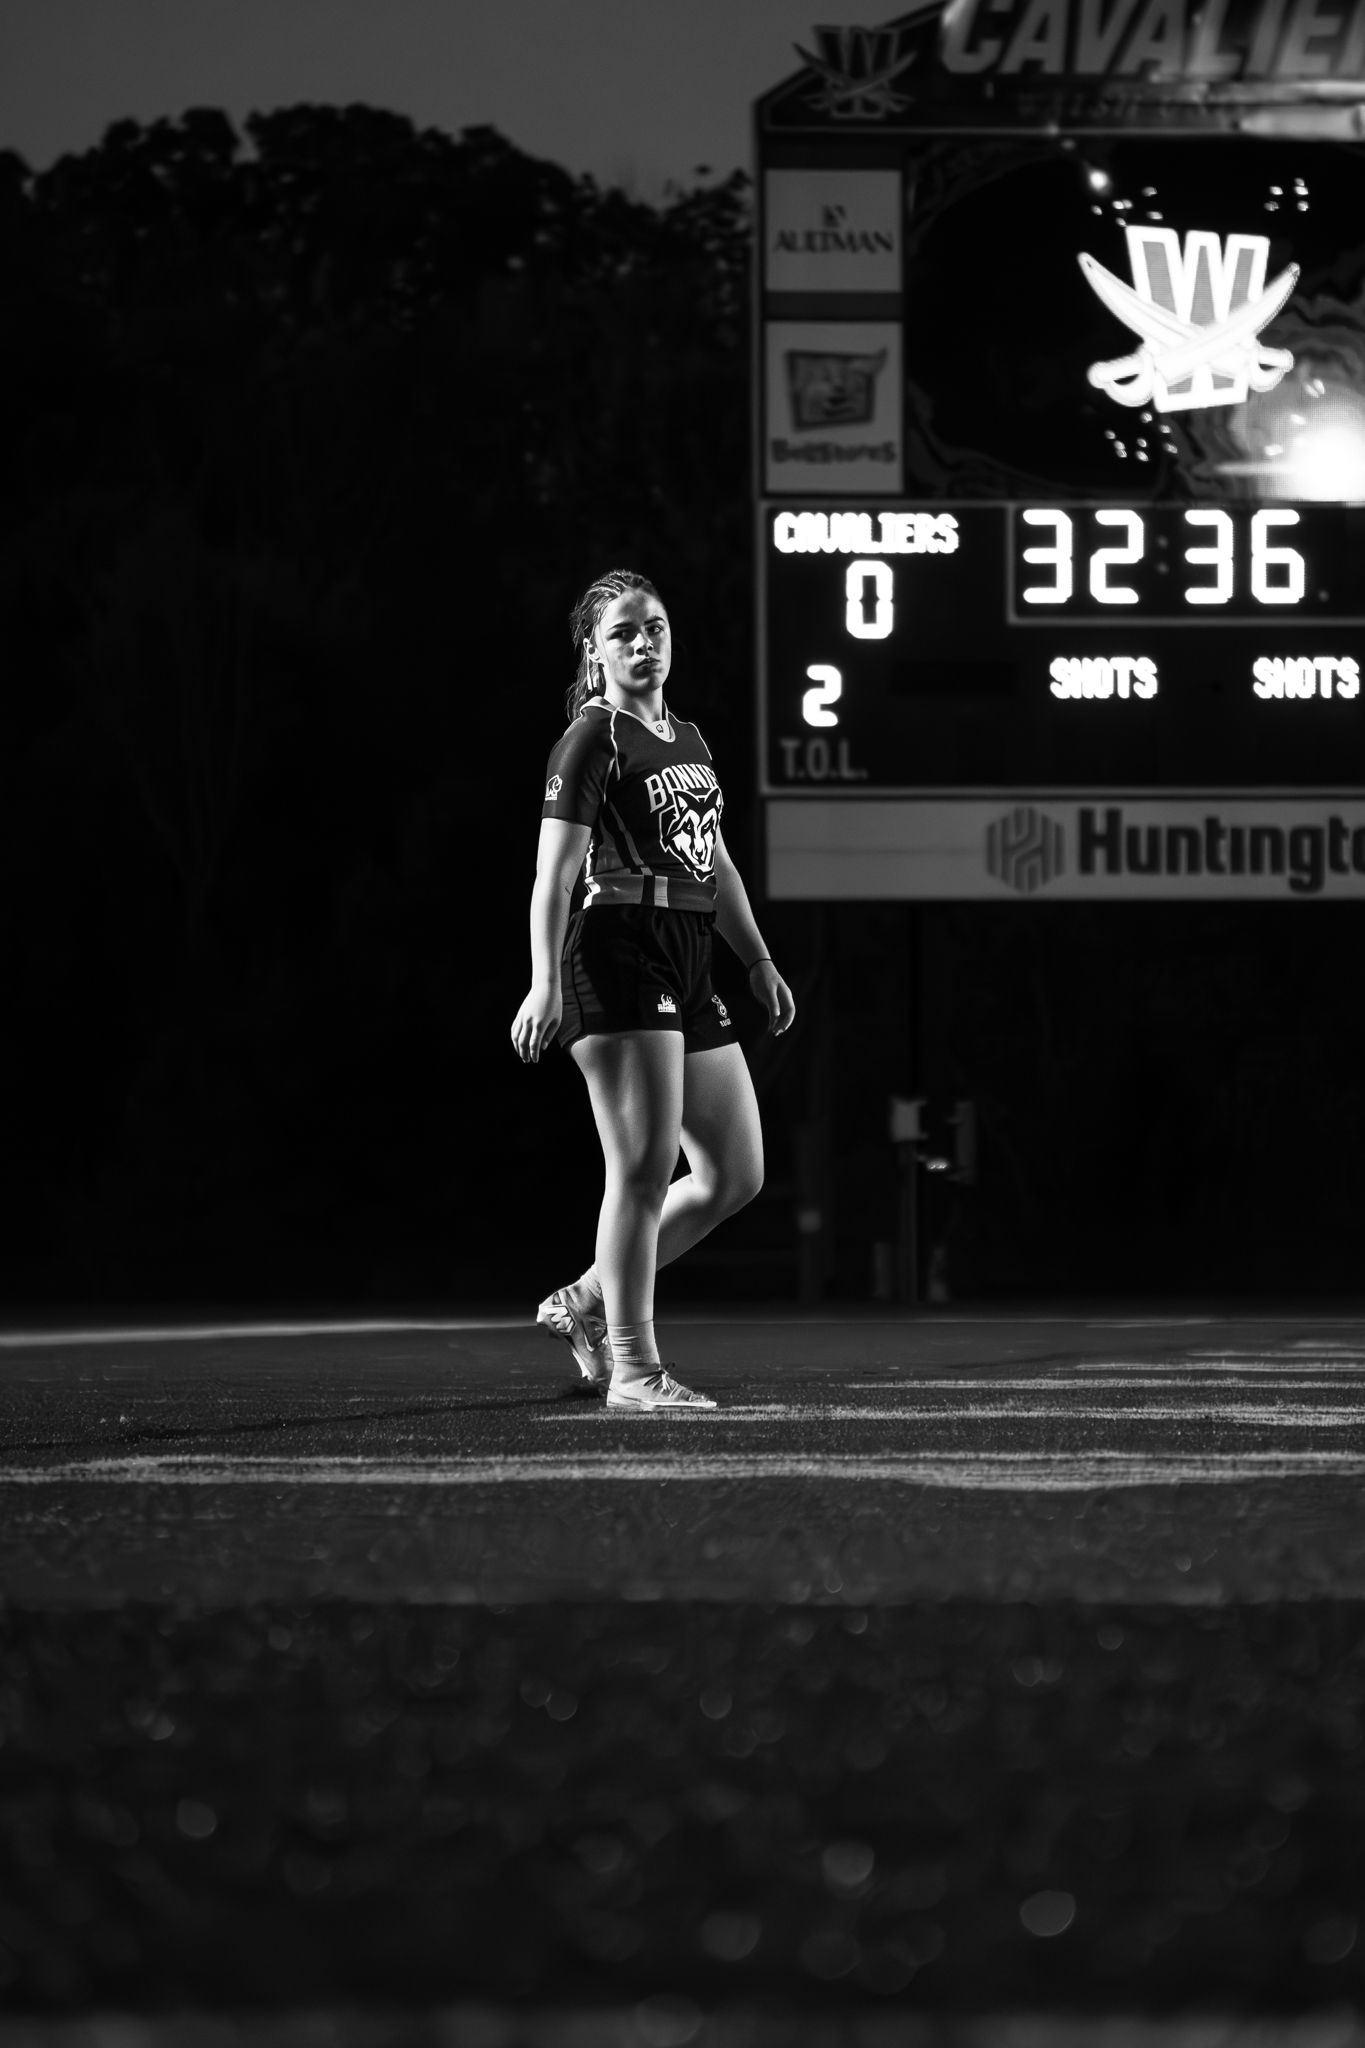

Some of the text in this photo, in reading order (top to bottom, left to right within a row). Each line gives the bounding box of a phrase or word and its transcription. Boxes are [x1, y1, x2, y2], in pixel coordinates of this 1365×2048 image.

[774, 512, 959, 553] CAVALIERS
[846, 561, 893, 639] 0
[802, 664, 842, 727] 2
[1050, 656, 1158, 699] SHOTS
[1252, 656, 1361, 699] SHOTS
